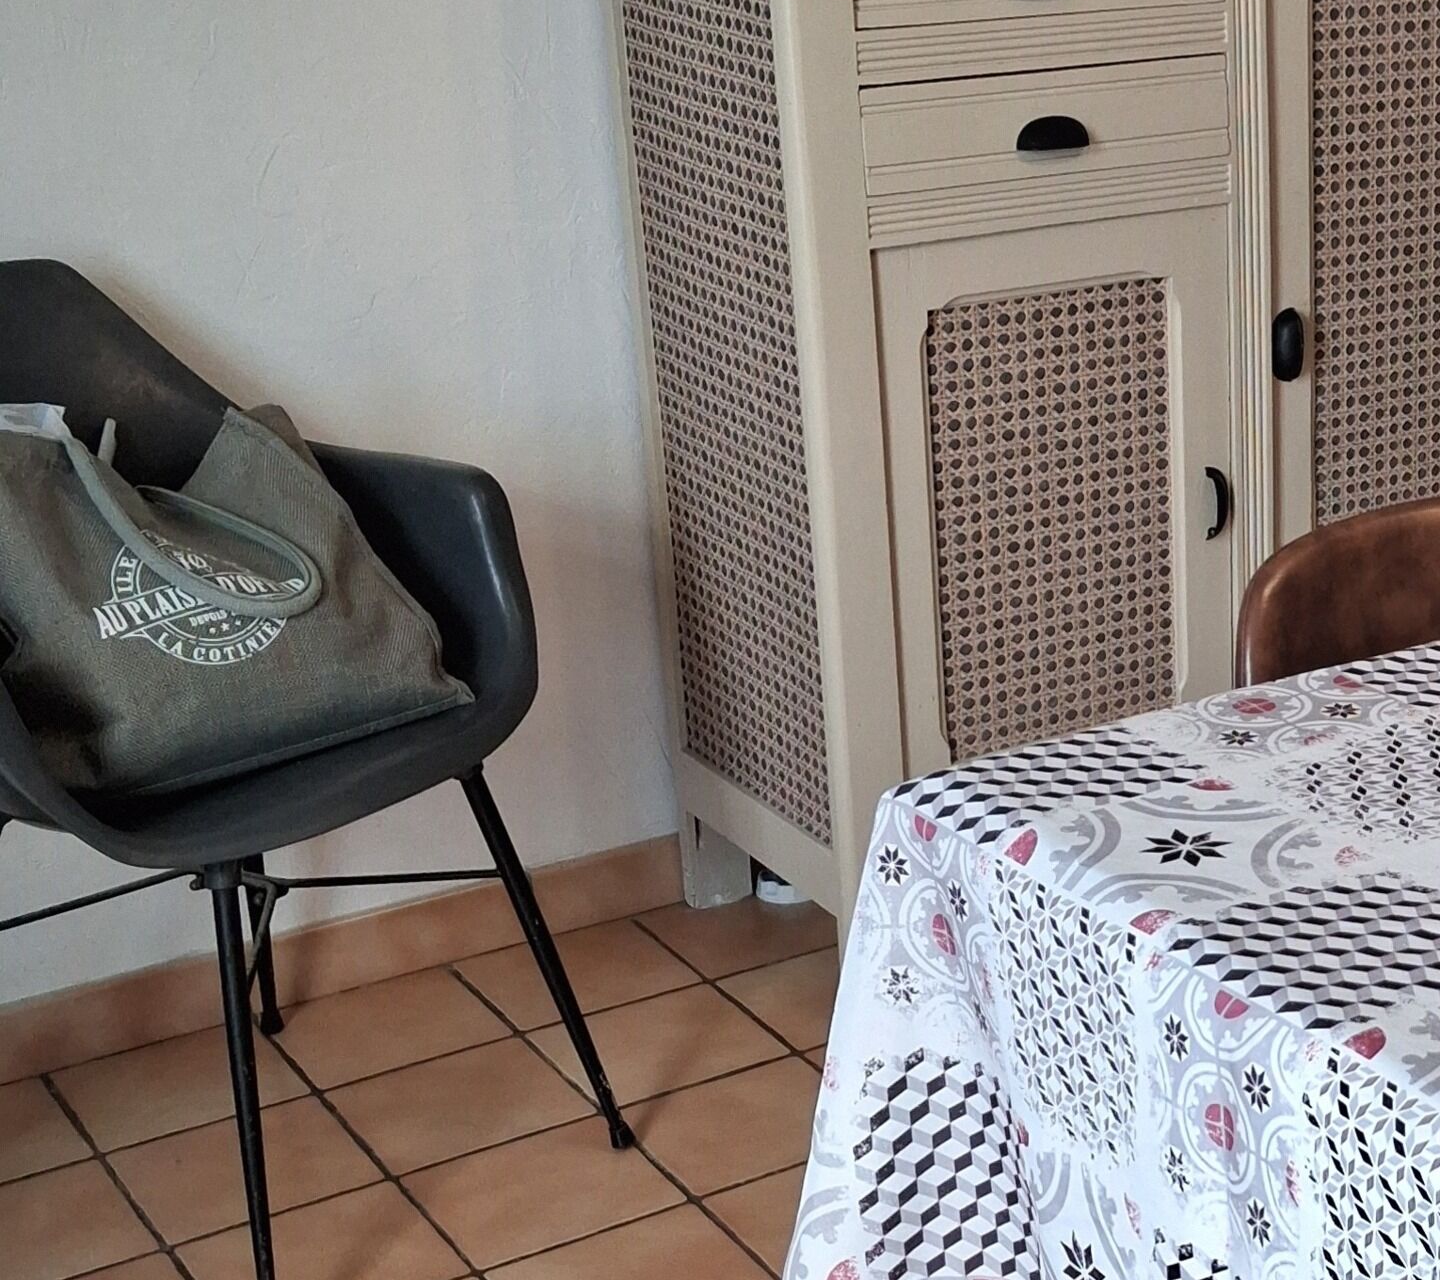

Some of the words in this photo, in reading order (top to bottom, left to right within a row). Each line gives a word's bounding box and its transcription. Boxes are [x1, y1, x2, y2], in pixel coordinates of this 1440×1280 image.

[92, 604, 129, 639] AU
[121, 587, 206, 625] PLAIS
[157, 631, 183, 657] LA
